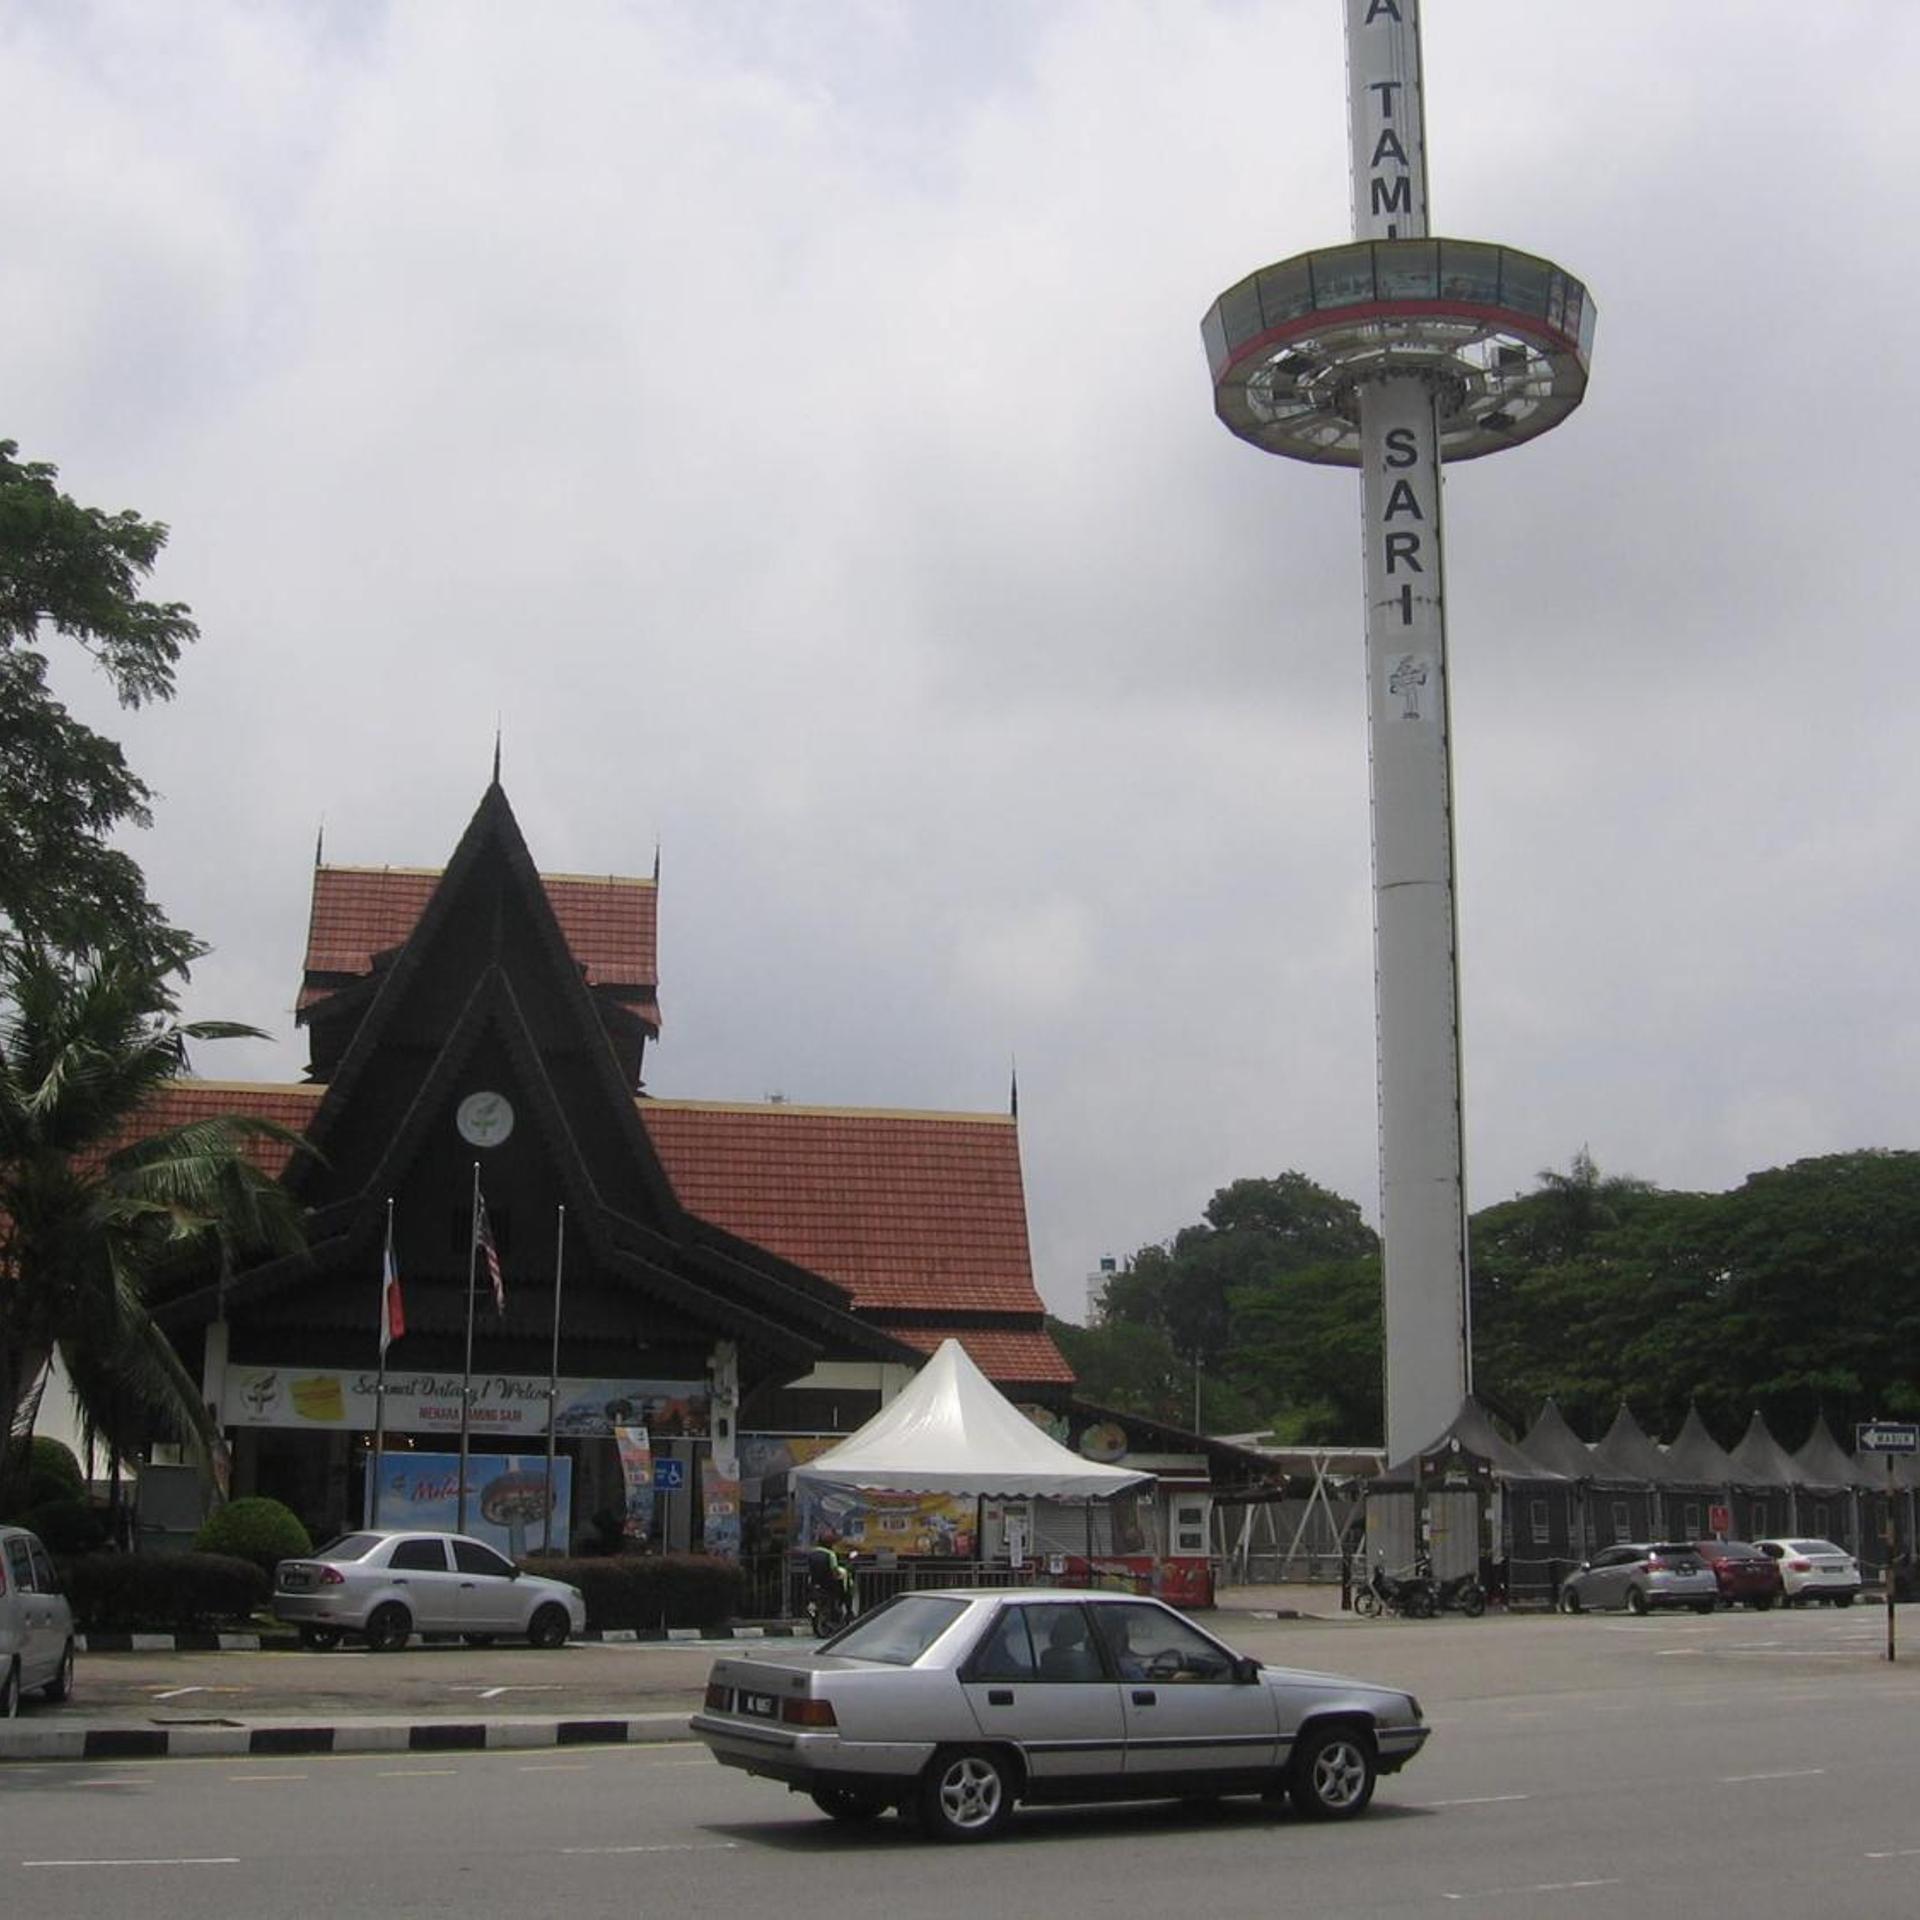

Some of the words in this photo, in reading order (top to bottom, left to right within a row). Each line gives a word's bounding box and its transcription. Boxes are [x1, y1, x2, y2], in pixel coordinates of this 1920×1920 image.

[1383, 428, 1425, 626] SARI
[352, 1374, 418, 1396] Seamat
[463, 1408, 498, 1421] AMING
